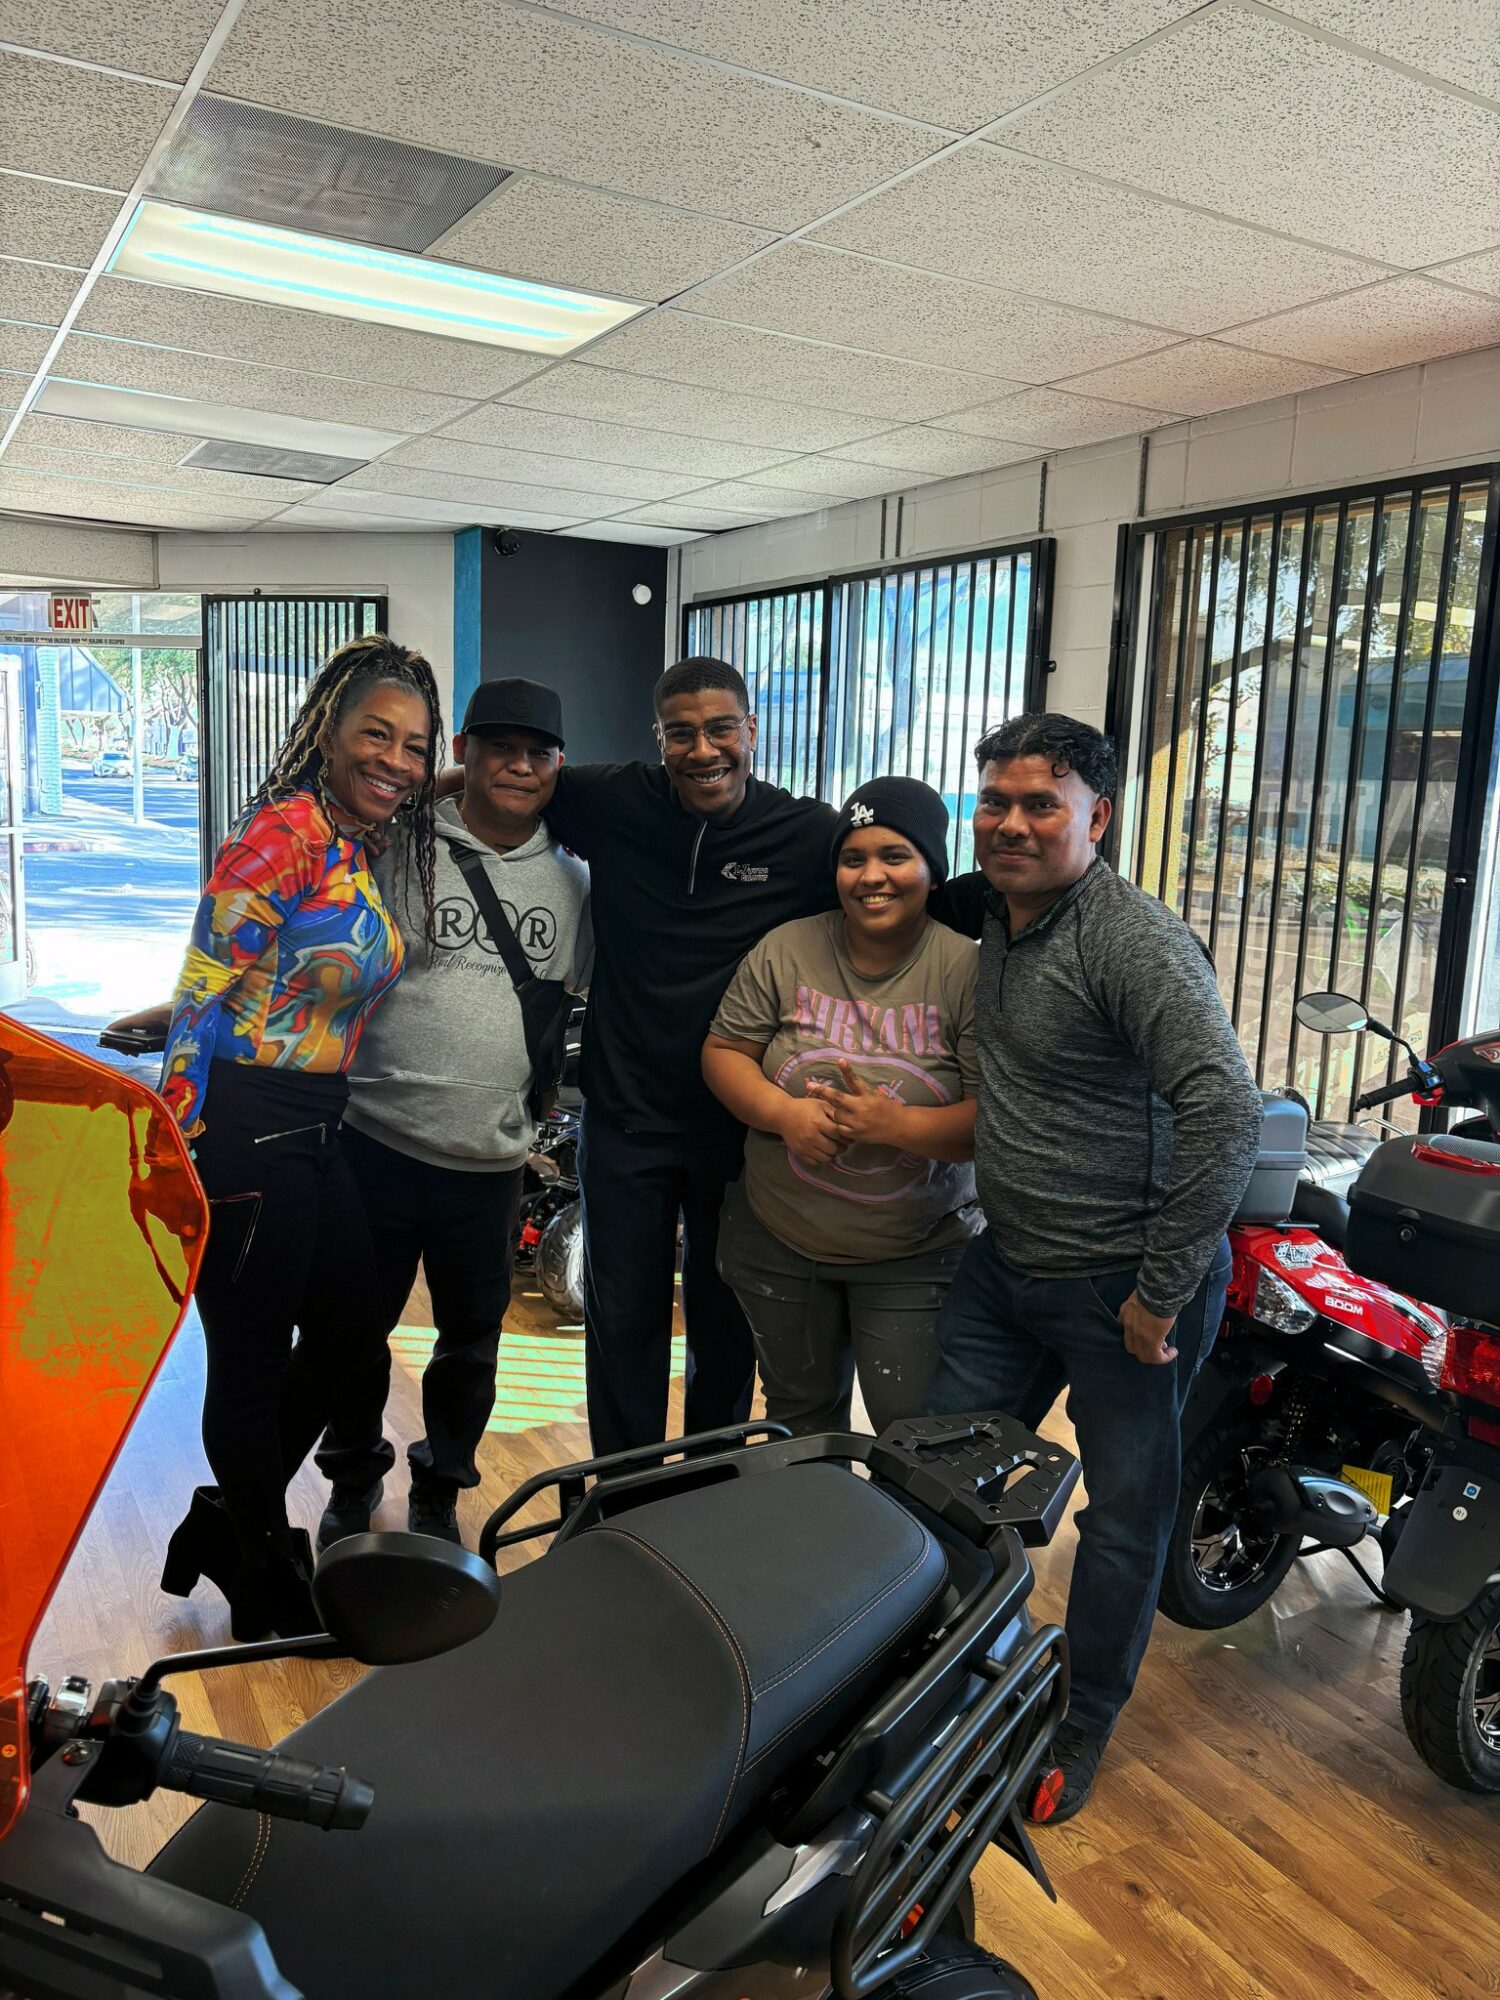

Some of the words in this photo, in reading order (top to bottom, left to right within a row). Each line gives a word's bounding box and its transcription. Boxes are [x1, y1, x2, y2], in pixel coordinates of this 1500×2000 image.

[54, 599, 89, 629] EXIT
[850, 802, 874, 827] LA
[1325, 1295, 1363, 1316] BOOM
